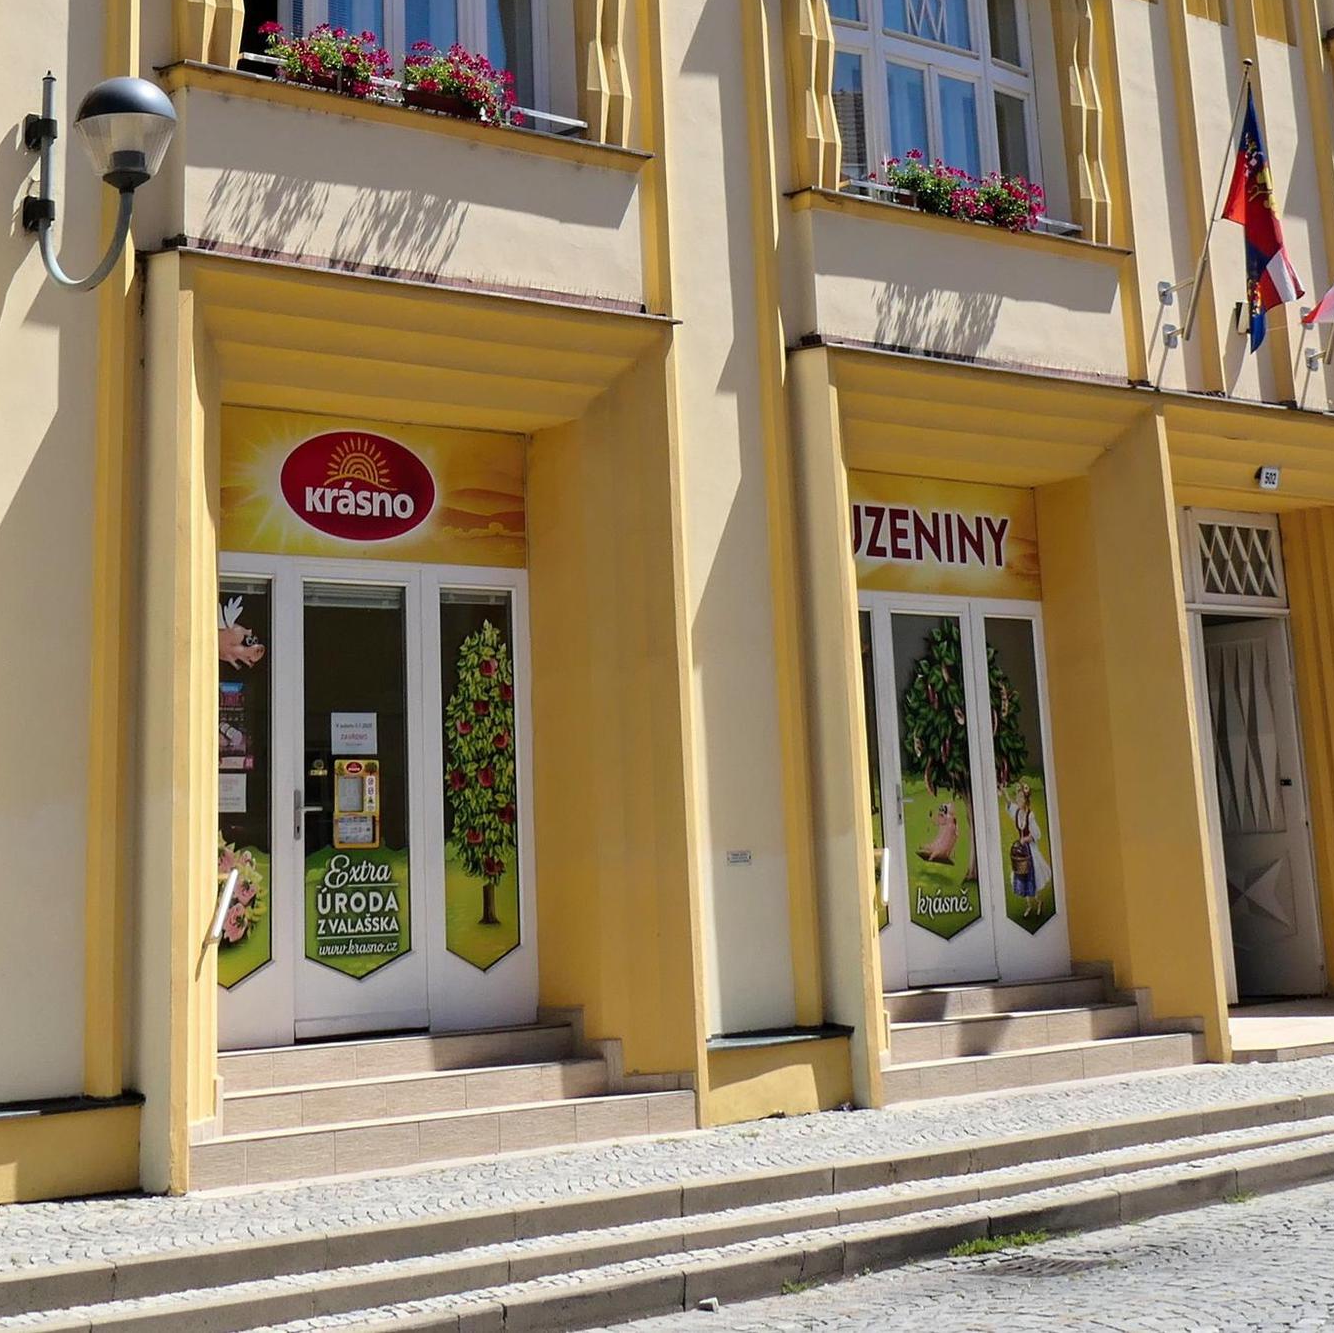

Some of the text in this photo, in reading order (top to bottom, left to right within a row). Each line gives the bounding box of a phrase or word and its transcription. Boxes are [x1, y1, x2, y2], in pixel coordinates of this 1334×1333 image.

[1265, 471, 1276, 484] 502
[324, 854, 392, 888] Extra
[317, 887, 399, 915] ÚRODA
[917, 887, 973, 920] krásně.
[317, 913, 399, 935] Z VALAŠSKA
[319, 939, 398, 956] www.krasno.cz
